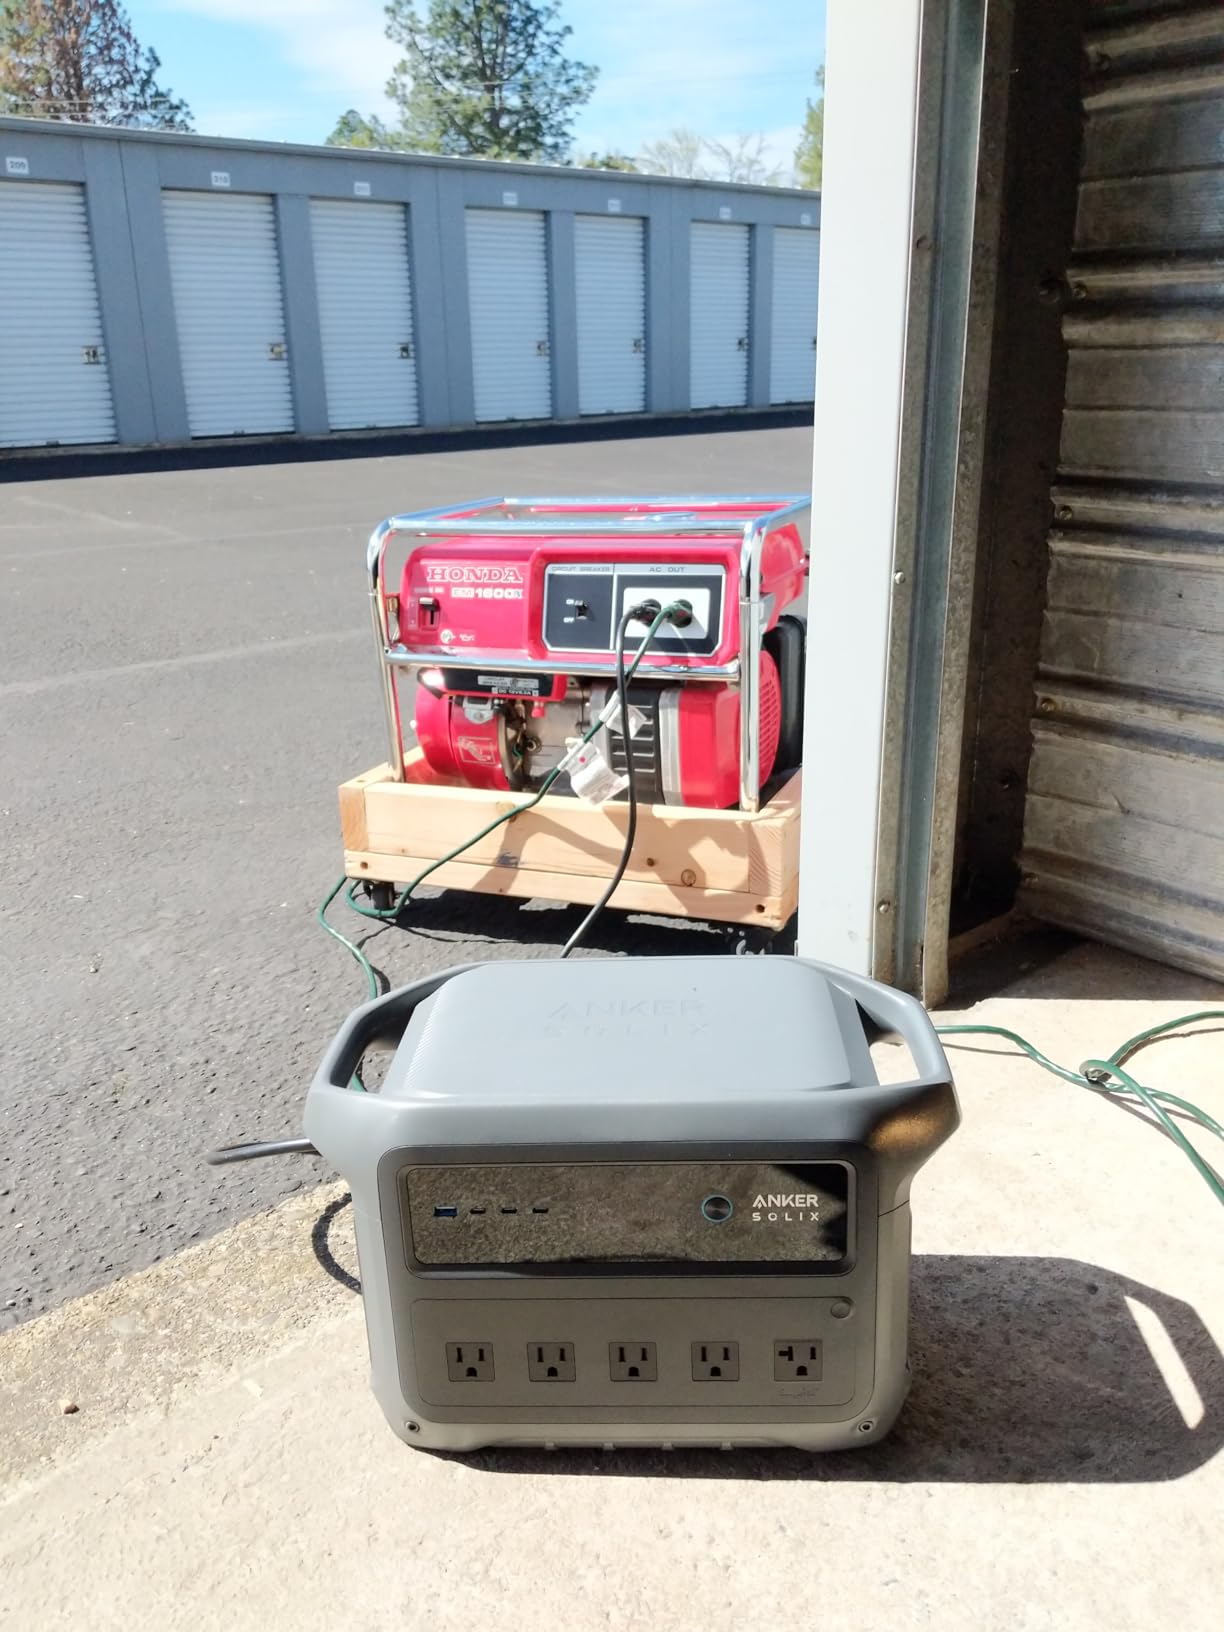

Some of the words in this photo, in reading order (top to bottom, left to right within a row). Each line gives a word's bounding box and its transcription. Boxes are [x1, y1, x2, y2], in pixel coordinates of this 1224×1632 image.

[427, 566, 524, 584] HONDA
[547, 999, 705, 1019] ANKER
[545, 1023, 710, 1039] SOLIX
[752, 1193, 819, 1208] ANKER
[752, 1212, 819, 1221] SOLIX
